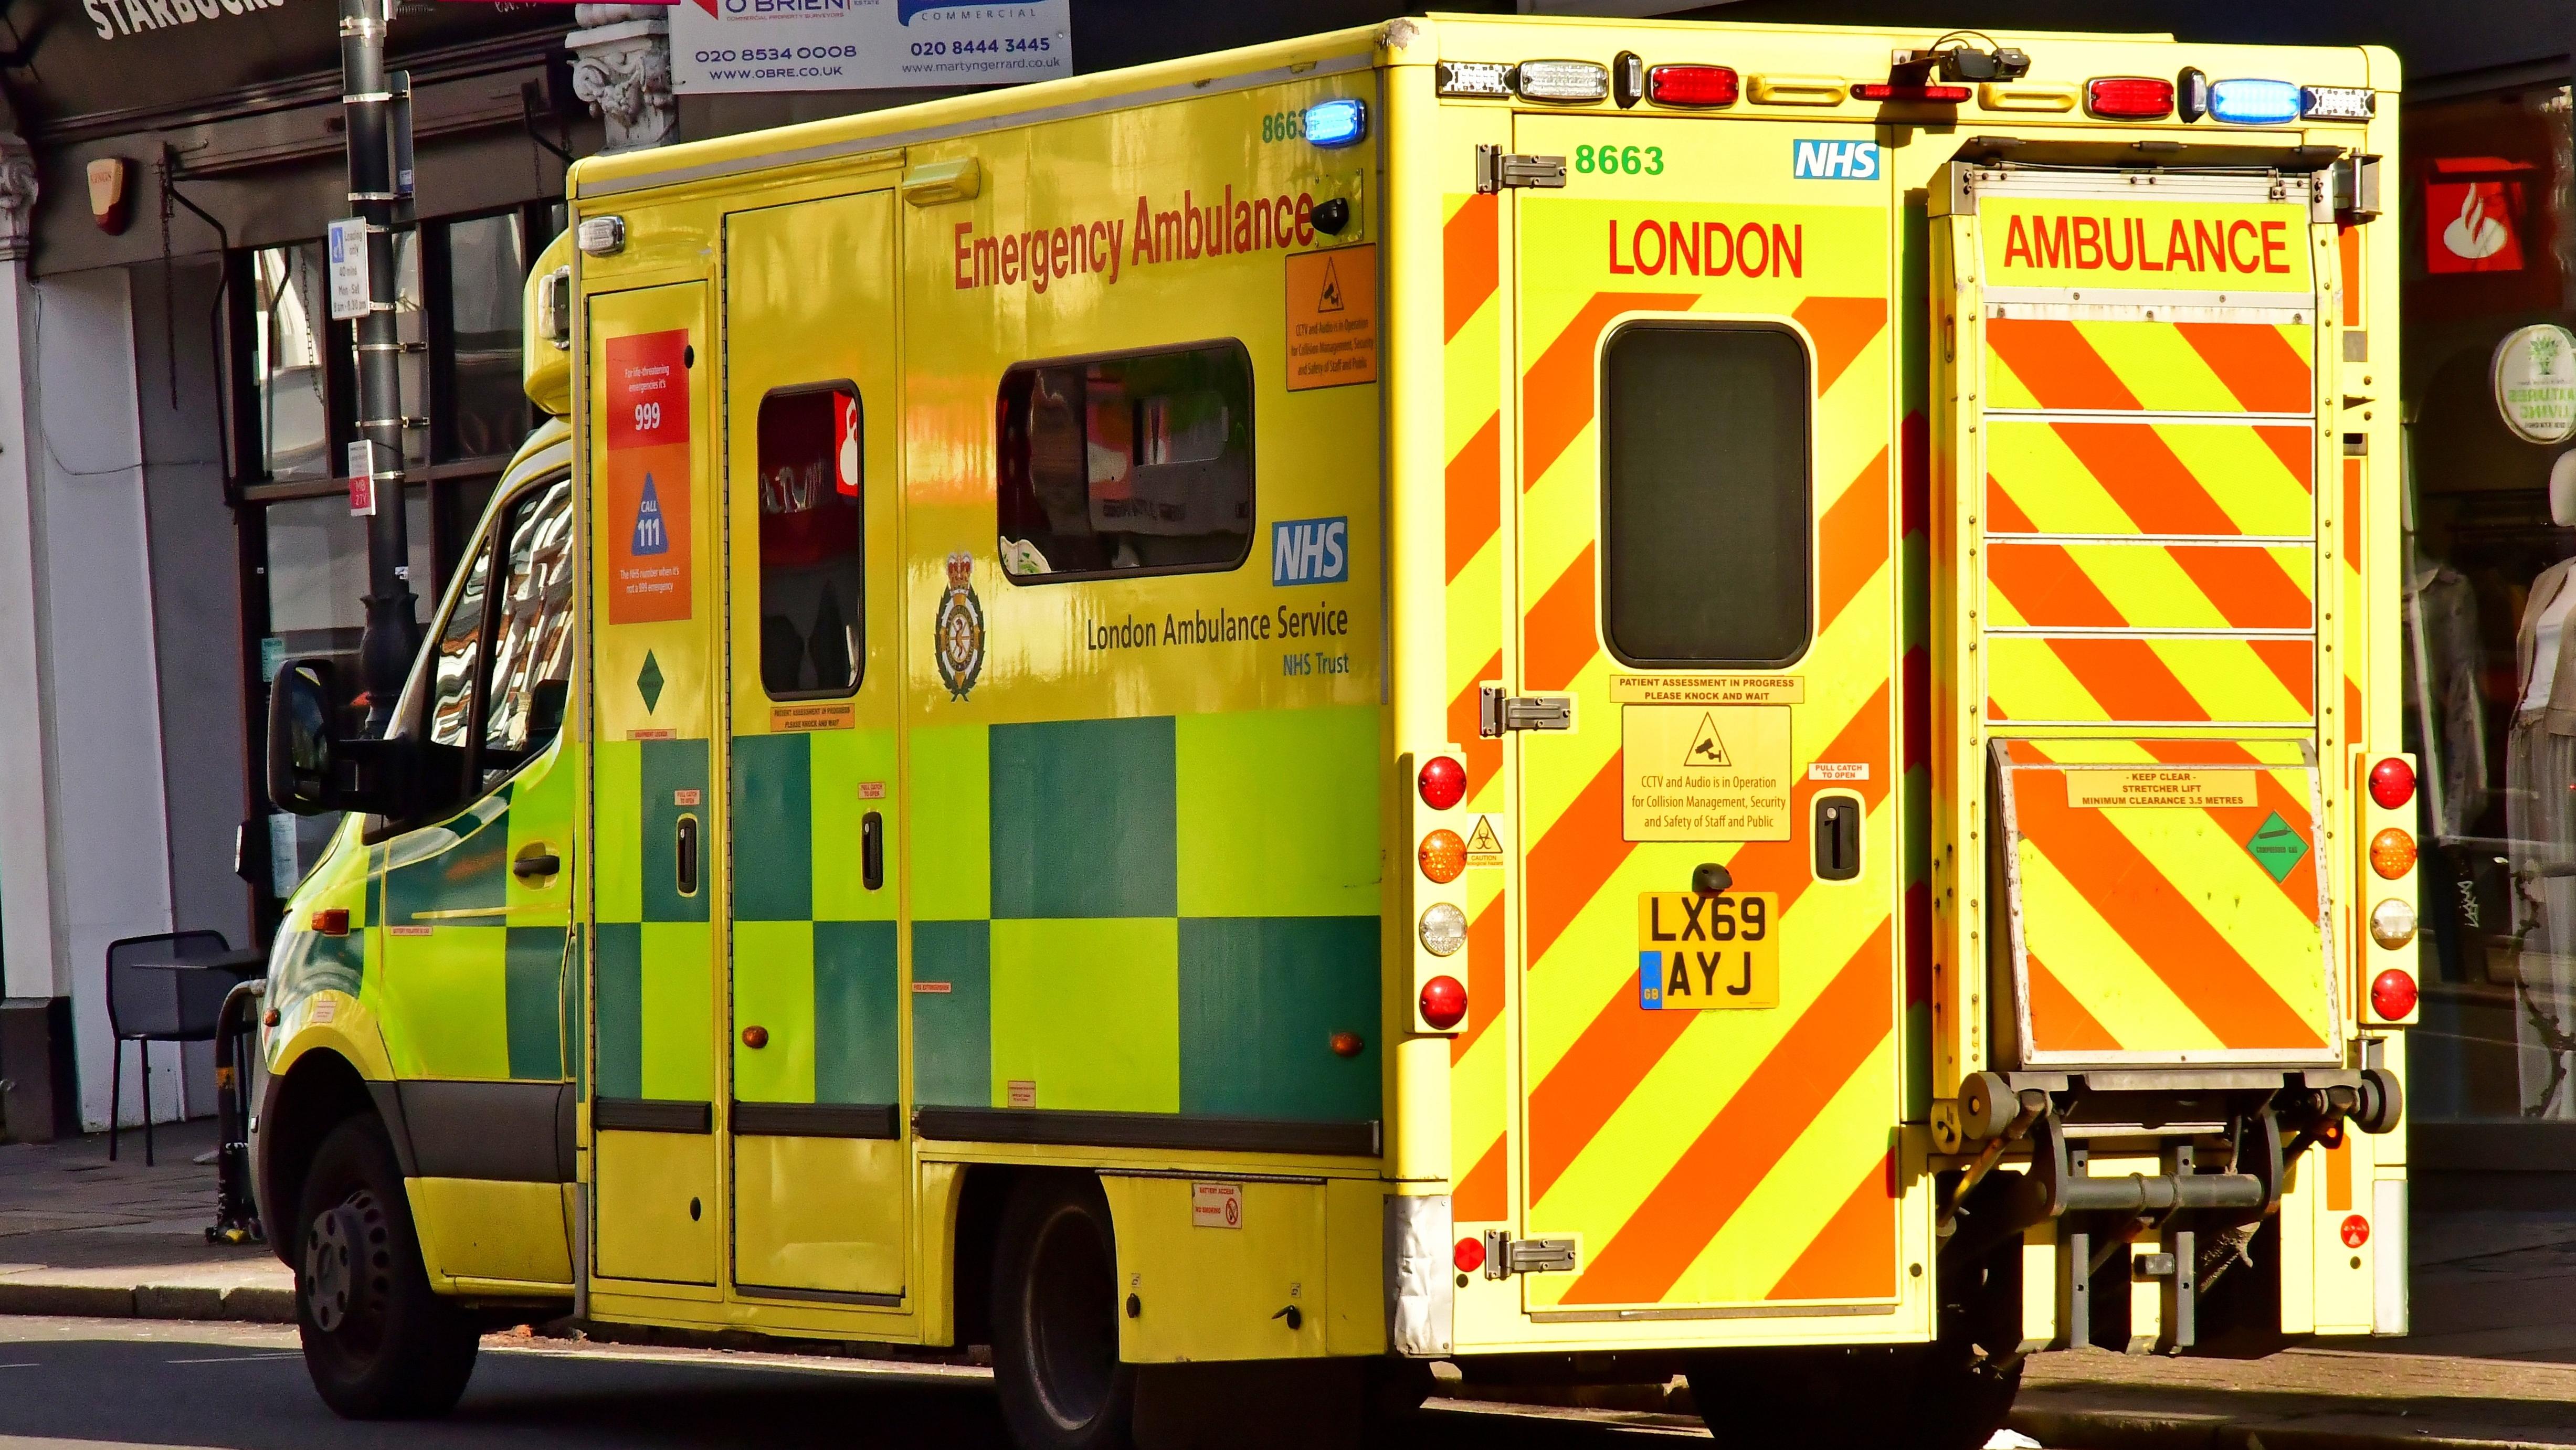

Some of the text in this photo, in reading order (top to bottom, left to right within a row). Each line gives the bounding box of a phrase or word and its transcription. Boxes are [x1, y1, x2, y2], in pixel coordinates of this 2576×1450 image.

[725, 0, 843, 13] OBRIEN
[922, 9, 1036, 20] COMMERCIAL
[83, 0, 284, 40] STARB
[695, 46, 857, 63] 020 8534 0008
[911, 37, 1050, 56] 020 8444 3445
[710, 67, 842, 80] WWW.OBRE.CO.UK
[902, 57, 1060, 73] www.martyngerrard.co.uk
[1262, 109, 1307, 143] 8663
[1574, 144, 1664, 175] 8663
[1796, 142, 1876, 178] NHS
[955, 184, 1315, 294] Emergency Ambulance
[2004, 214, 2290, 274] AMBULANCE
[1609, 219, 1802, 278] LONDON
[1296, 323, 1307, 336] CCTV
[634, 365, 670, 377] life-threatening
[629, 382, 658, 393] emergencies
[635, 402, 660, 431] 999
[641, 501, 657, 513] CALL
[638, 518, 659, 547] 111
[1274, 522, 1345, 581] NHS
[620, 569, 629, 579] The
[630, 569, 639, 579] NHS
[639, 567, 658, 578] number
[659, 567, 672, 576] when
[639, 583, 647, 592] 999
[648, 581, 673, 593] emergency
[1088, 601, 1348, 650] London Ambulance Service
[1283, 652, 1349, 676] NHS Trust
[1743, 679, 1794, 687] PROGRESS
[1641, 776, 1776, 791] CCTV and Audio is in Operation
[1632, 796, 1786, 810] for Collision Management, Security
[1644, 816, 1773, 830] and Safety of Staff and Public
[1652, 897, 1765, 941] LX69
[1667, 951, 1751, 996] AYJ
[1644, 988, 1659, 1000] GB
